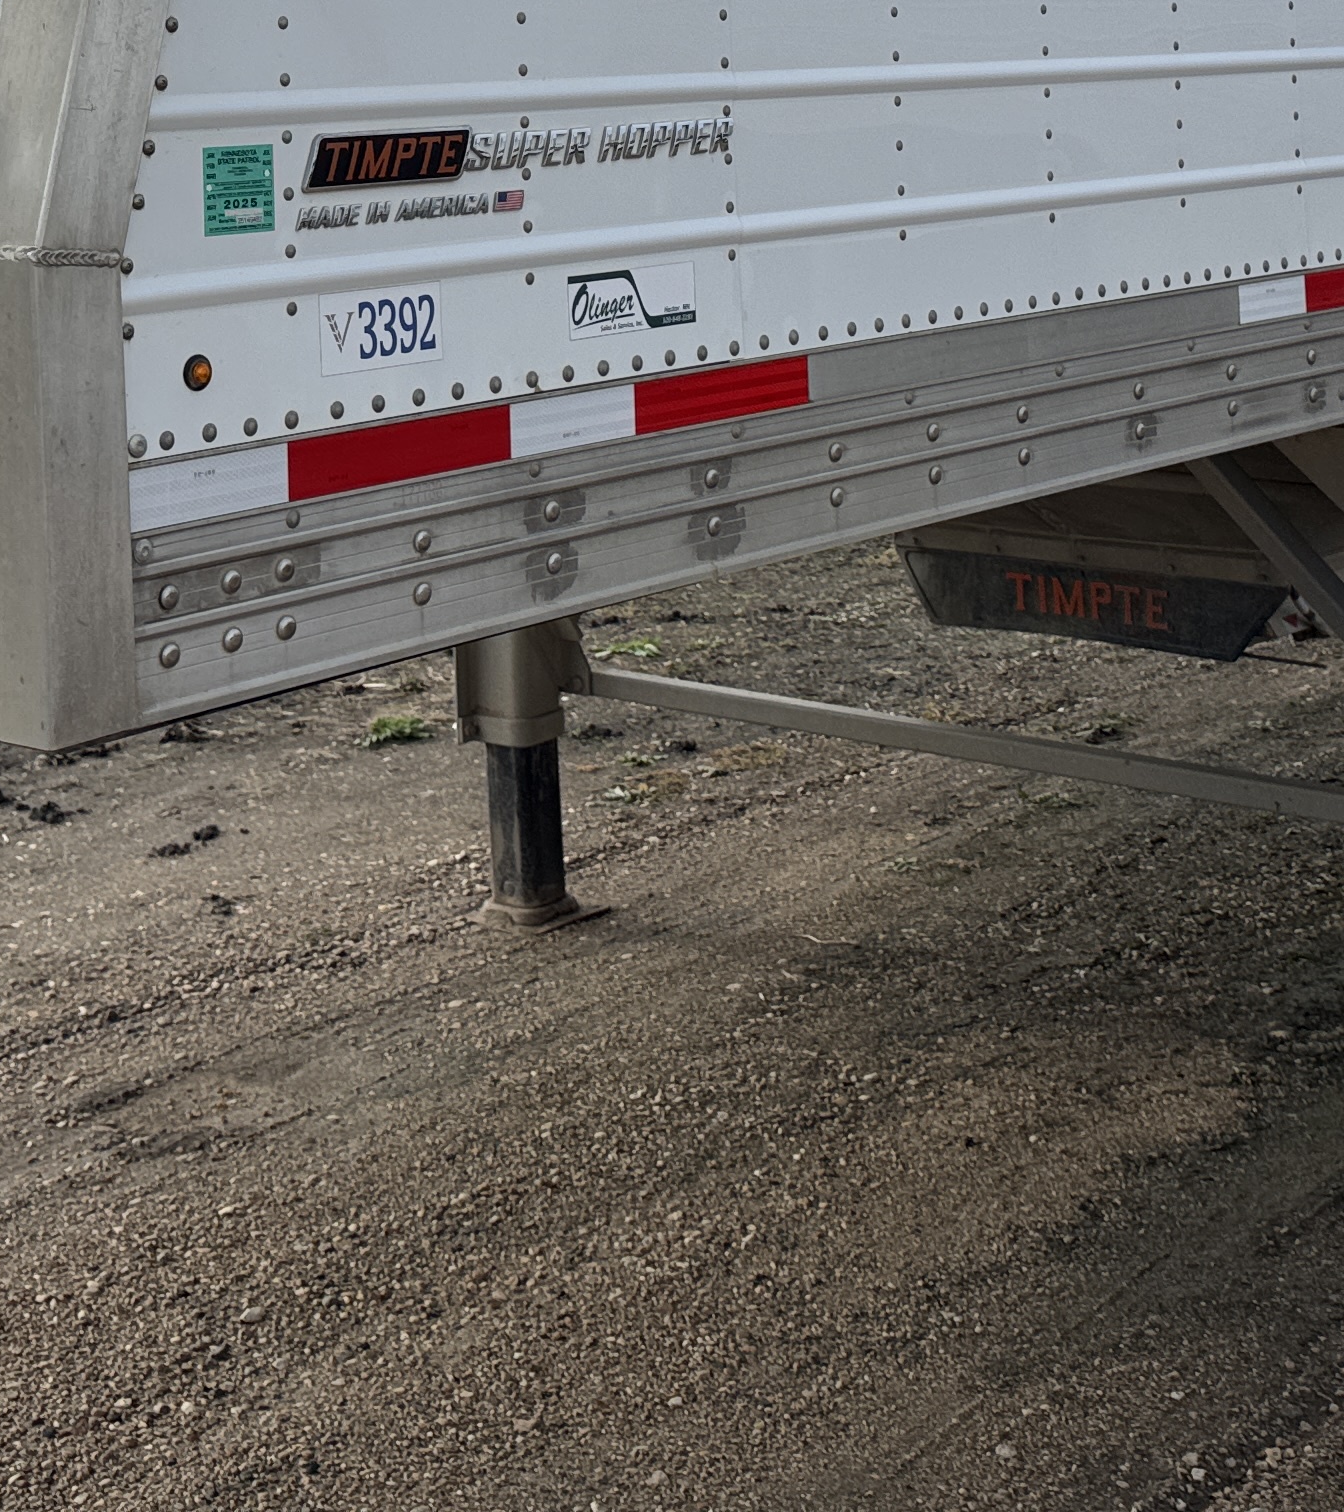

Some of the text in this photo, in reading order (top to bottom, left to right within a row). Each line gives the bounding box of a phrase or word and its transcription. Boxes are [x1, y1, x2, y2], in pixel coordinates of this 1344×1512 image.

[324, 116, 734, 183] TIMPTE SUPER HOPPER
[224, 197, 258, 210] 2025
[295, 191, 490, 232] MADE IN AMERICA
[357, 294, 437, 360] 3392
[571, 283, 635, 325] Olinger
[1006, 571, 1169, 631] TIMPTE
